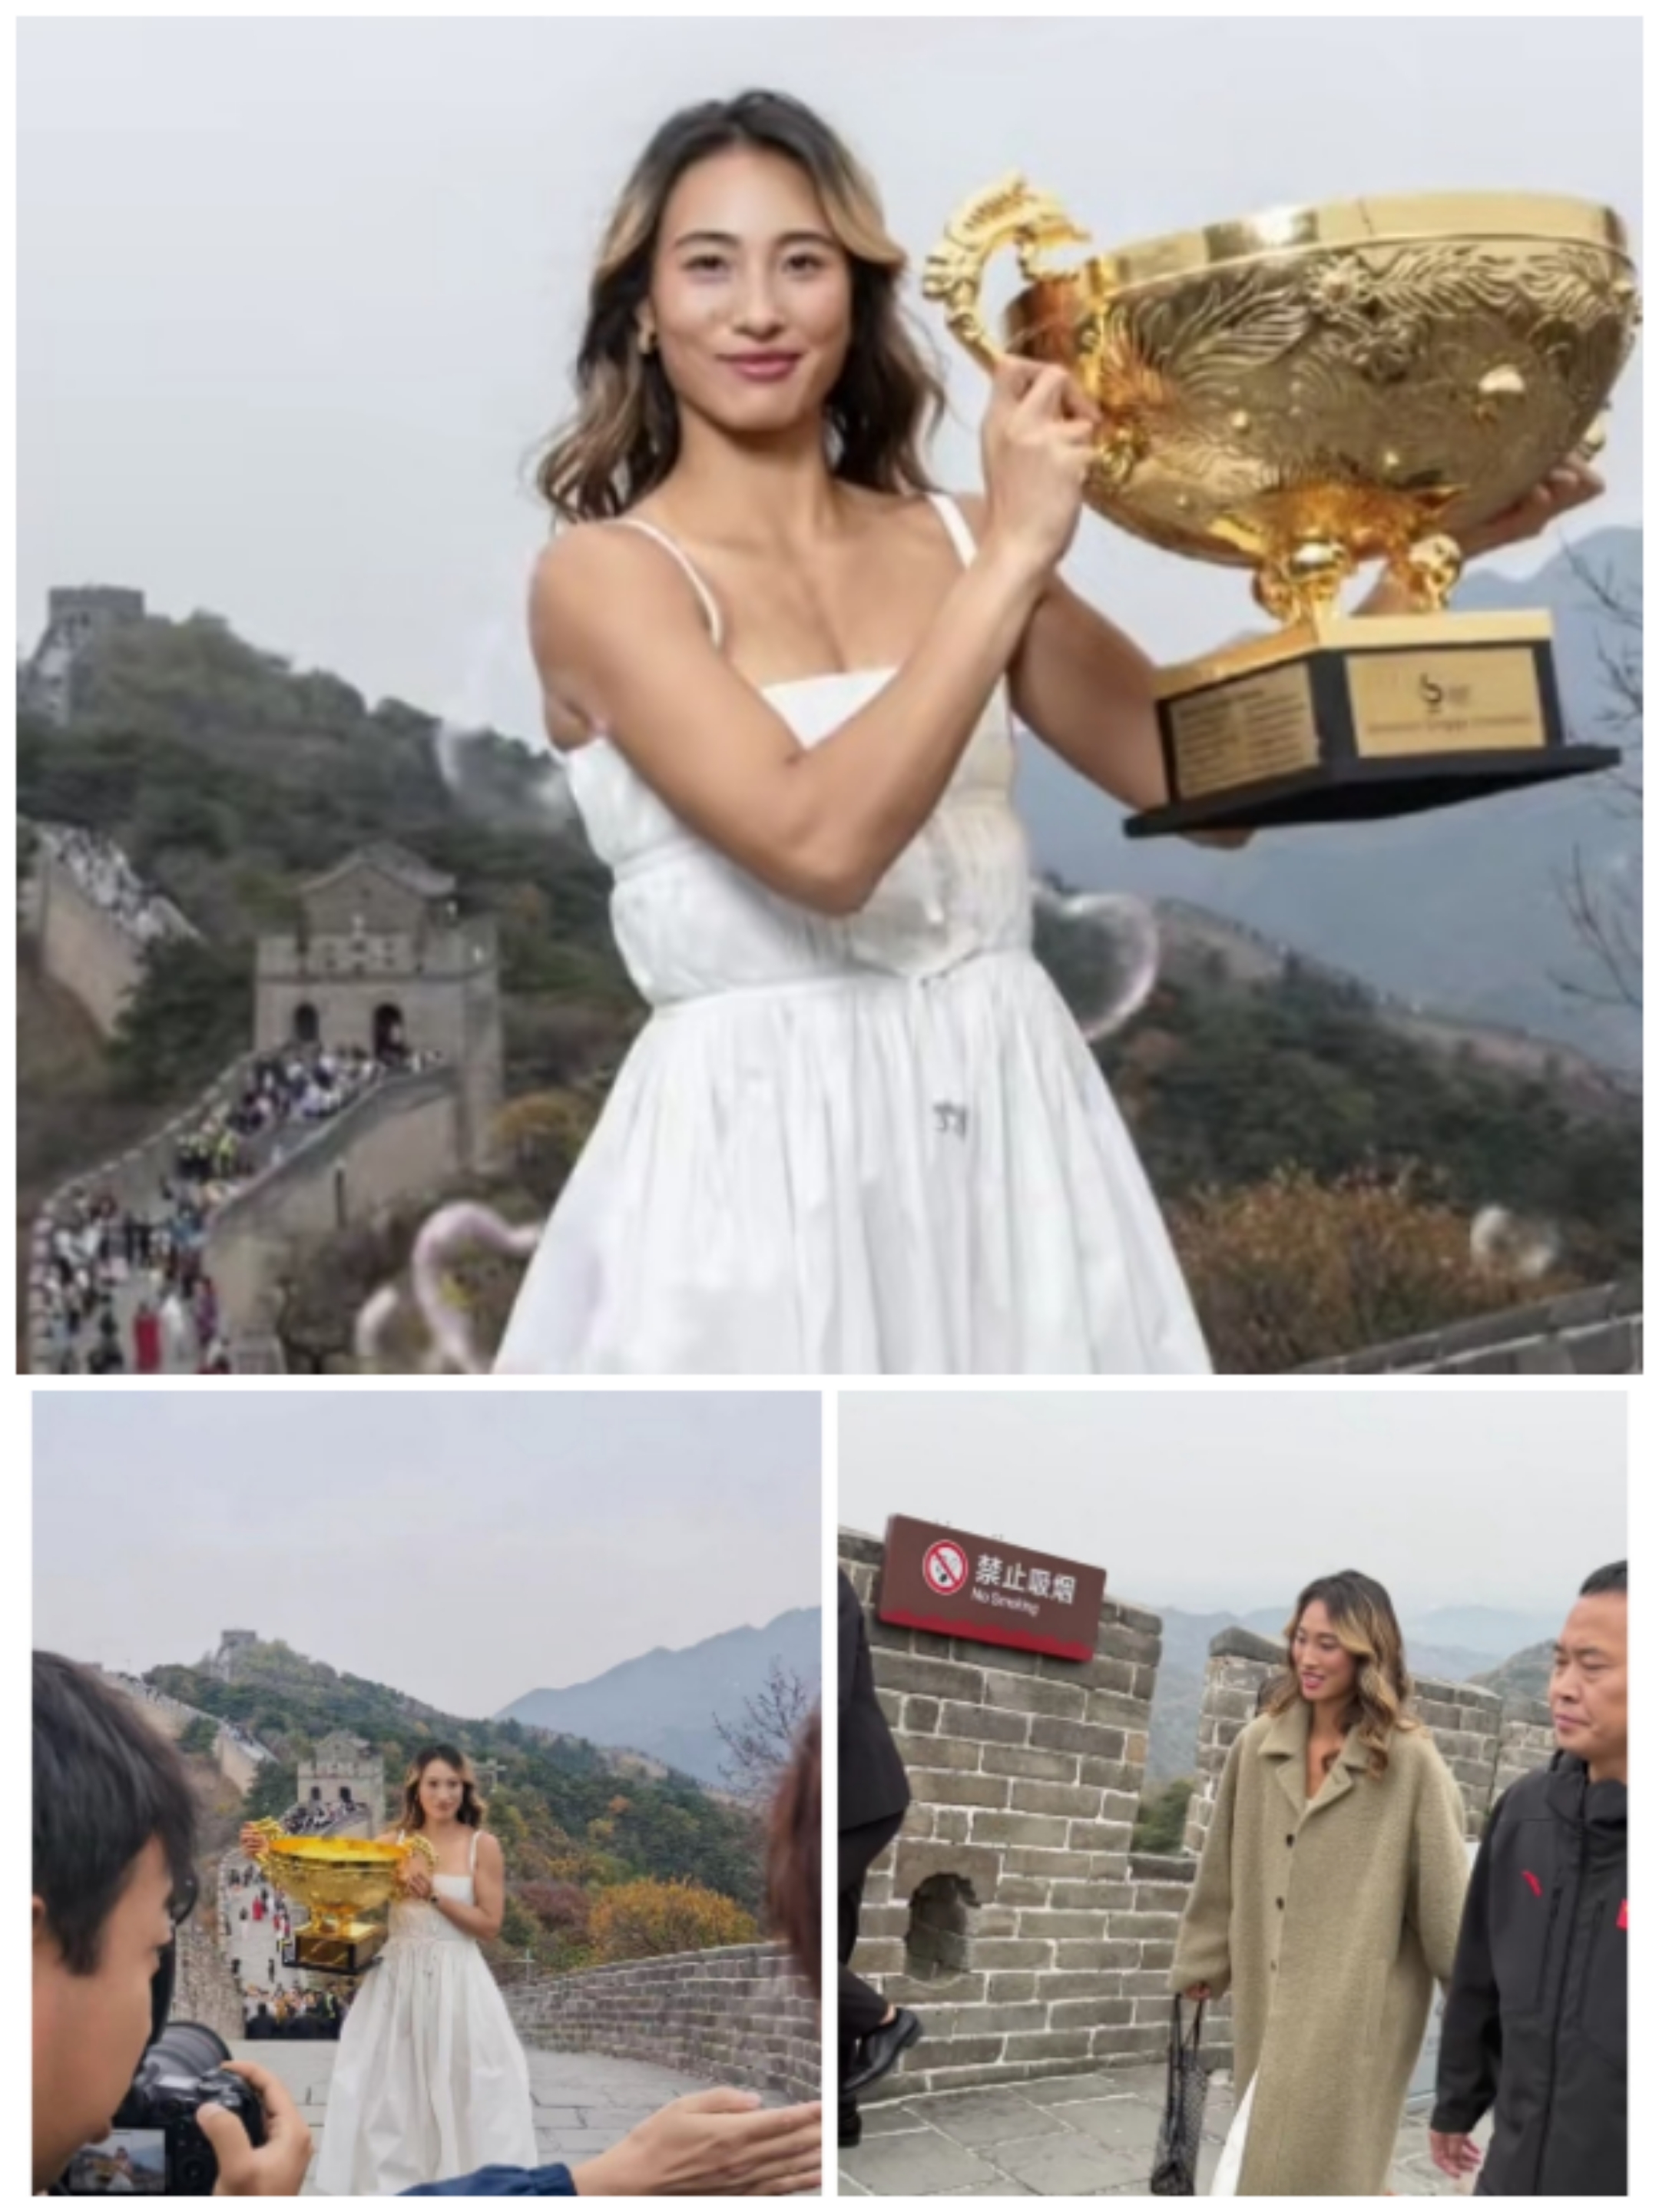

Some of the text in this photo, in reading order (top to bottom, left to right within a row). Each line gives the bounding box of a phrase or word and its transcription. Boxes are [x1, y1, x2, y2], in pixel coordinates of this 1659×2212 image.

[975, 1554, 1075, 1604] 禁止吸烟
[972, 1587, 1039, 1617] No Smoking
